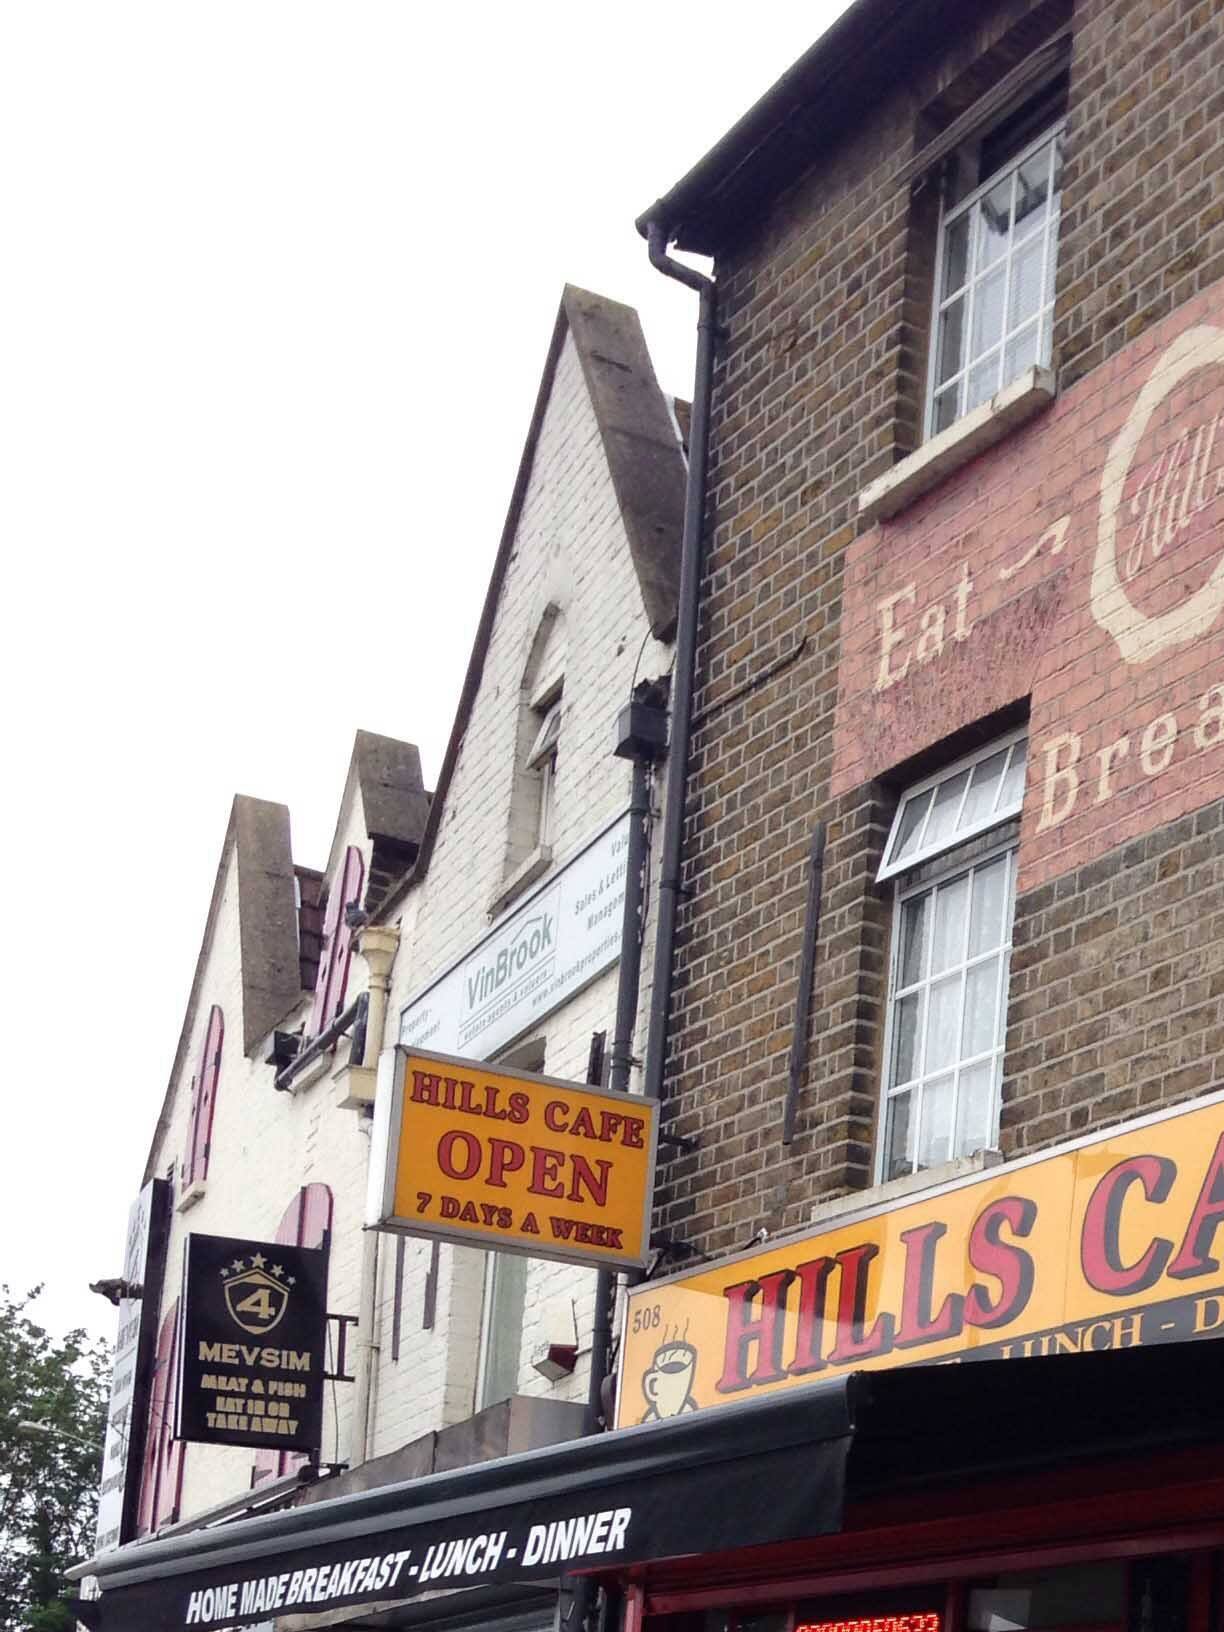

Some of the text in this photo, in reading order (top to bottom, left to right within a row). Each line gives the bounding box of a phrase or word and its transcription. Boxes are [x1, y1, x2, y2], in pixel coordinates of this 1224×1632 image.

[874, 562, 974, 693] Eat
[466, 912, 554, 1010] VinBrook
[410, 1070, 645, 1149] HILLS CAFE
[437, 1129, 613, 1207] OPEN
[416, 1192, 625, 1250] 7 DAYS A WEEK
[632, 1304, 662, 1335] 508
[715, 1195, 1038, 1395] HILLS
[198, 1340, 312, 1372] MEVSIM
[201, 1374, 249, 1393] MEAT
[206, 1411, 249, 1431] TAKE
[185, 1583, 239, 1625] HOME
[239, 1573, 288, 1616] MADE
[284, 1549, 411, 1605] BREAKFAST
[418, 1531, 507, 1583] LUNCH
[521, 1507, 633, 1567] DINNER
